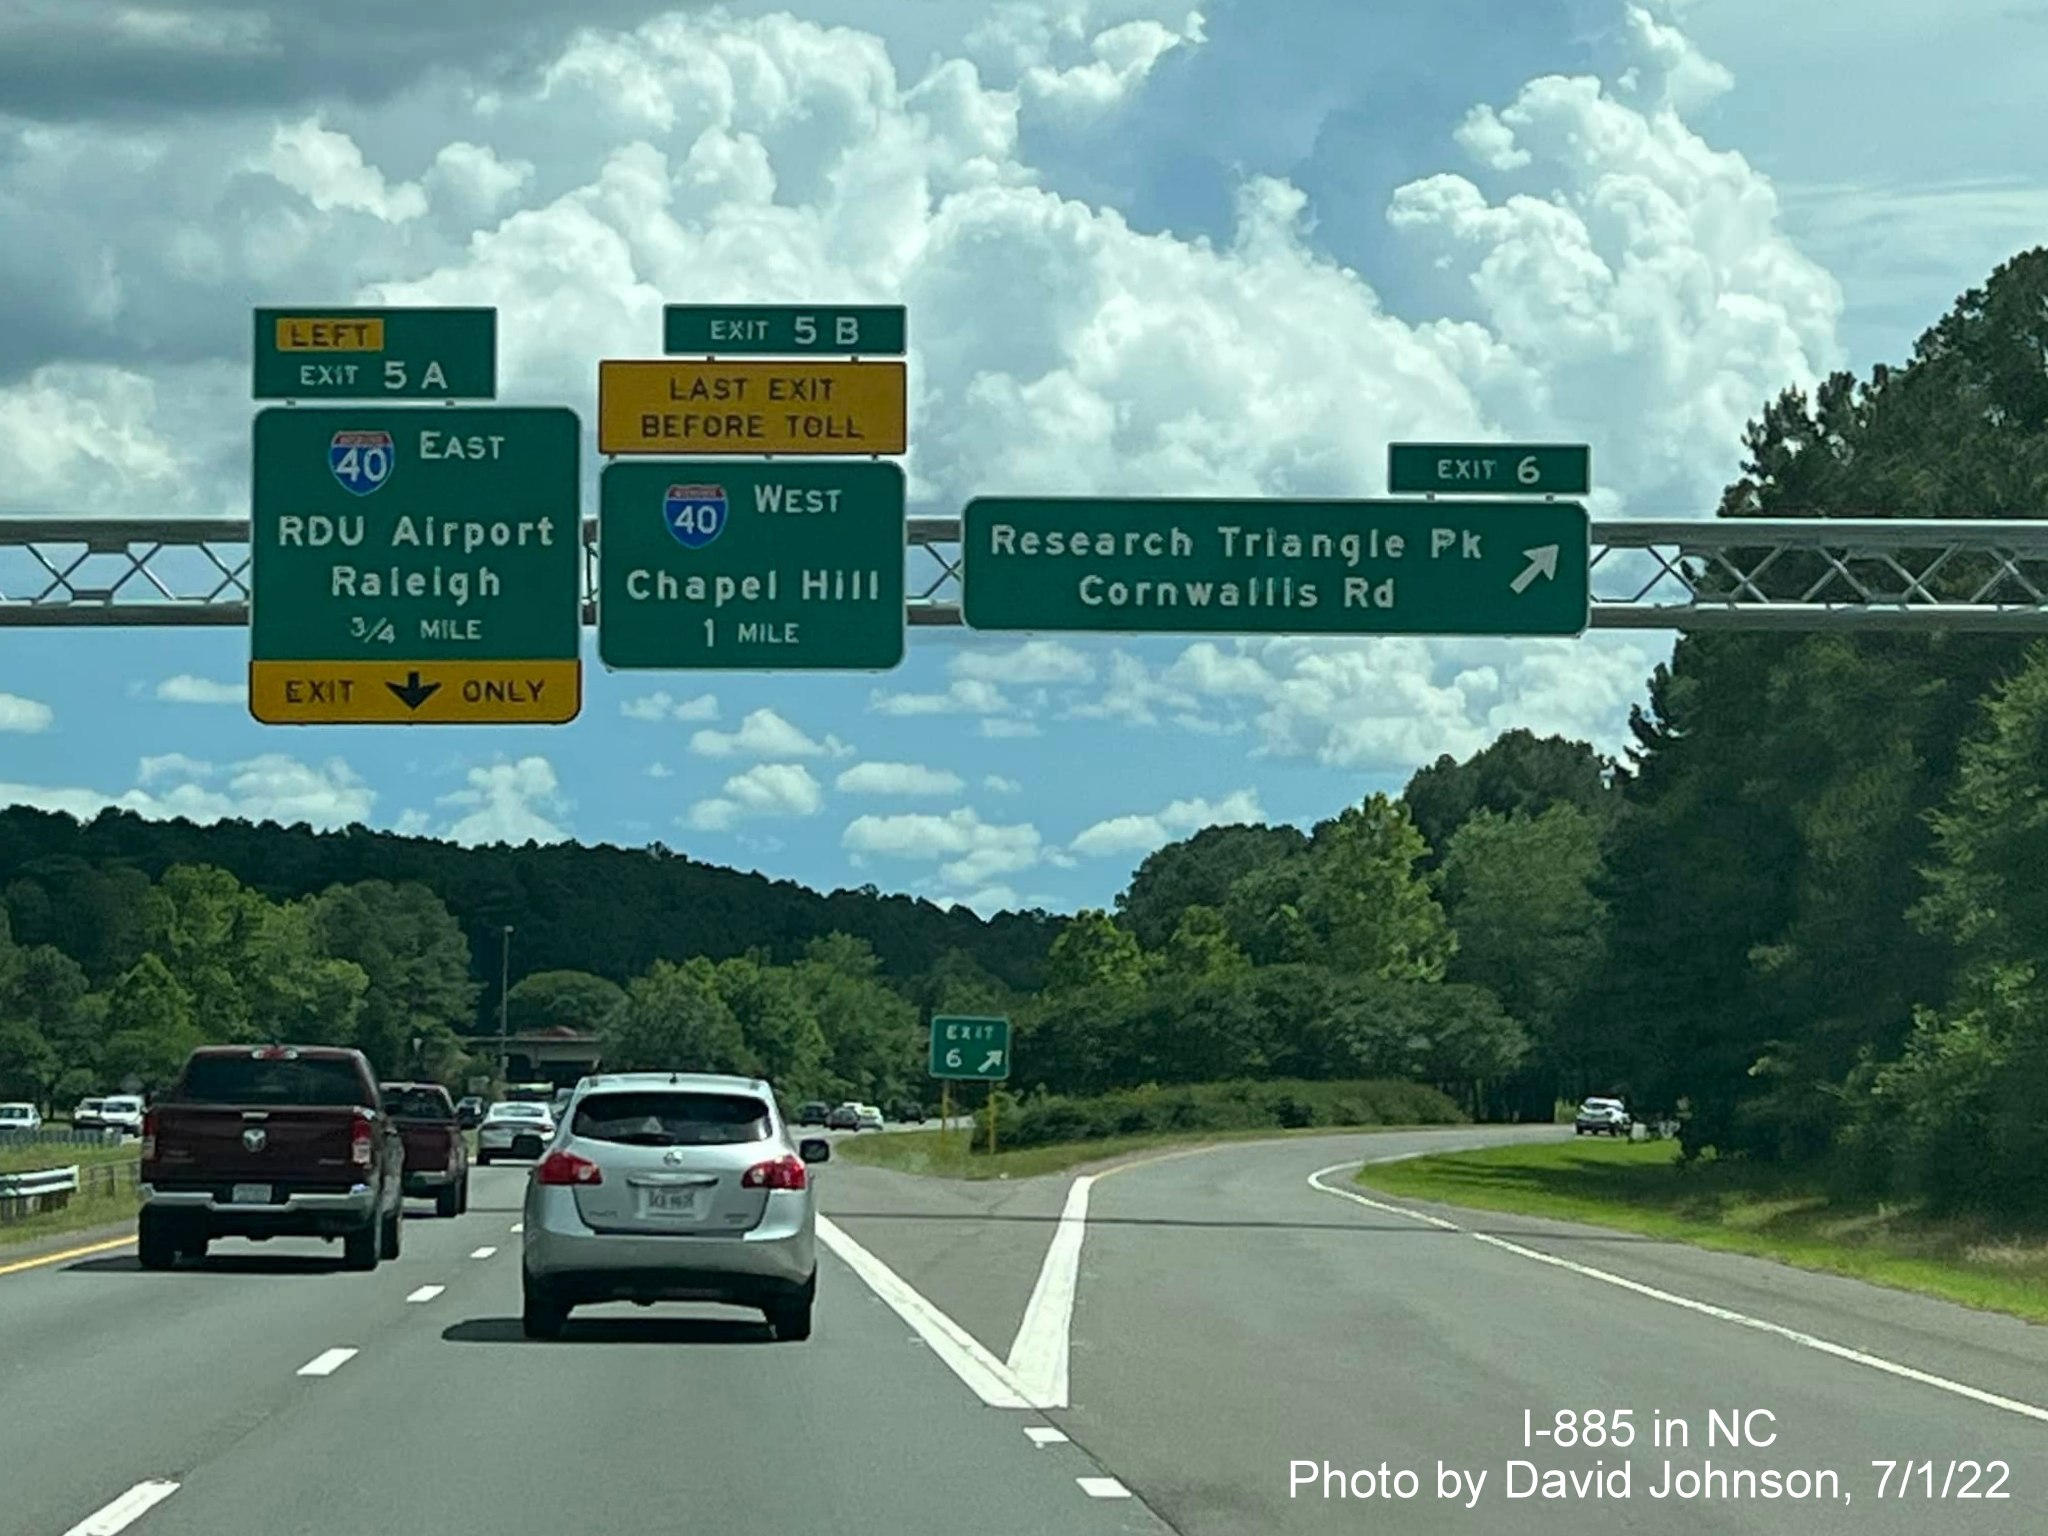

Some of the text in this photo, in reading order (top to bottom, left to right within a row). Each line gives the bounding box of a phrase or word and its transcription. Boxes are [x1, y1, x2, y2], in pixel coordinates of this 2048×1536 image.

[290, 322, 369, 347] LEFT
[709, 316, 859, 345] EXIT 5 B
[300, 361, 448, 389] EXIT 5 A
[669, 378, 834, 400] LAST EXIT
[641, 414, 865, 438] BEFORE TOLL
[419, 430, 505, 460] EAST
[334, 448, 388, 482] 40
[1437, 455, 1541, 485] EXIT 6
[753, 484, 842, 514] WEST
[278, 515, 554, 553] RDU Airport
[674, 505, 718, 535] 40
[990, 524, 1483, 567] Research Triangle Pk
[331, 565, 500, 606] Raleigh
[626, 568, 879, 607] Chapel Hill
[1078, 575, 1395, 609] Cornwallis Rd
[419, 619, 482, 640] MILE
[703, 618, 800, 647] 1 MILE
[286, 680, 545, 704] EXIT ONLY
[945, 1025, 993, 1040] EXIT
[945, 1048, 962, 1068] 6
